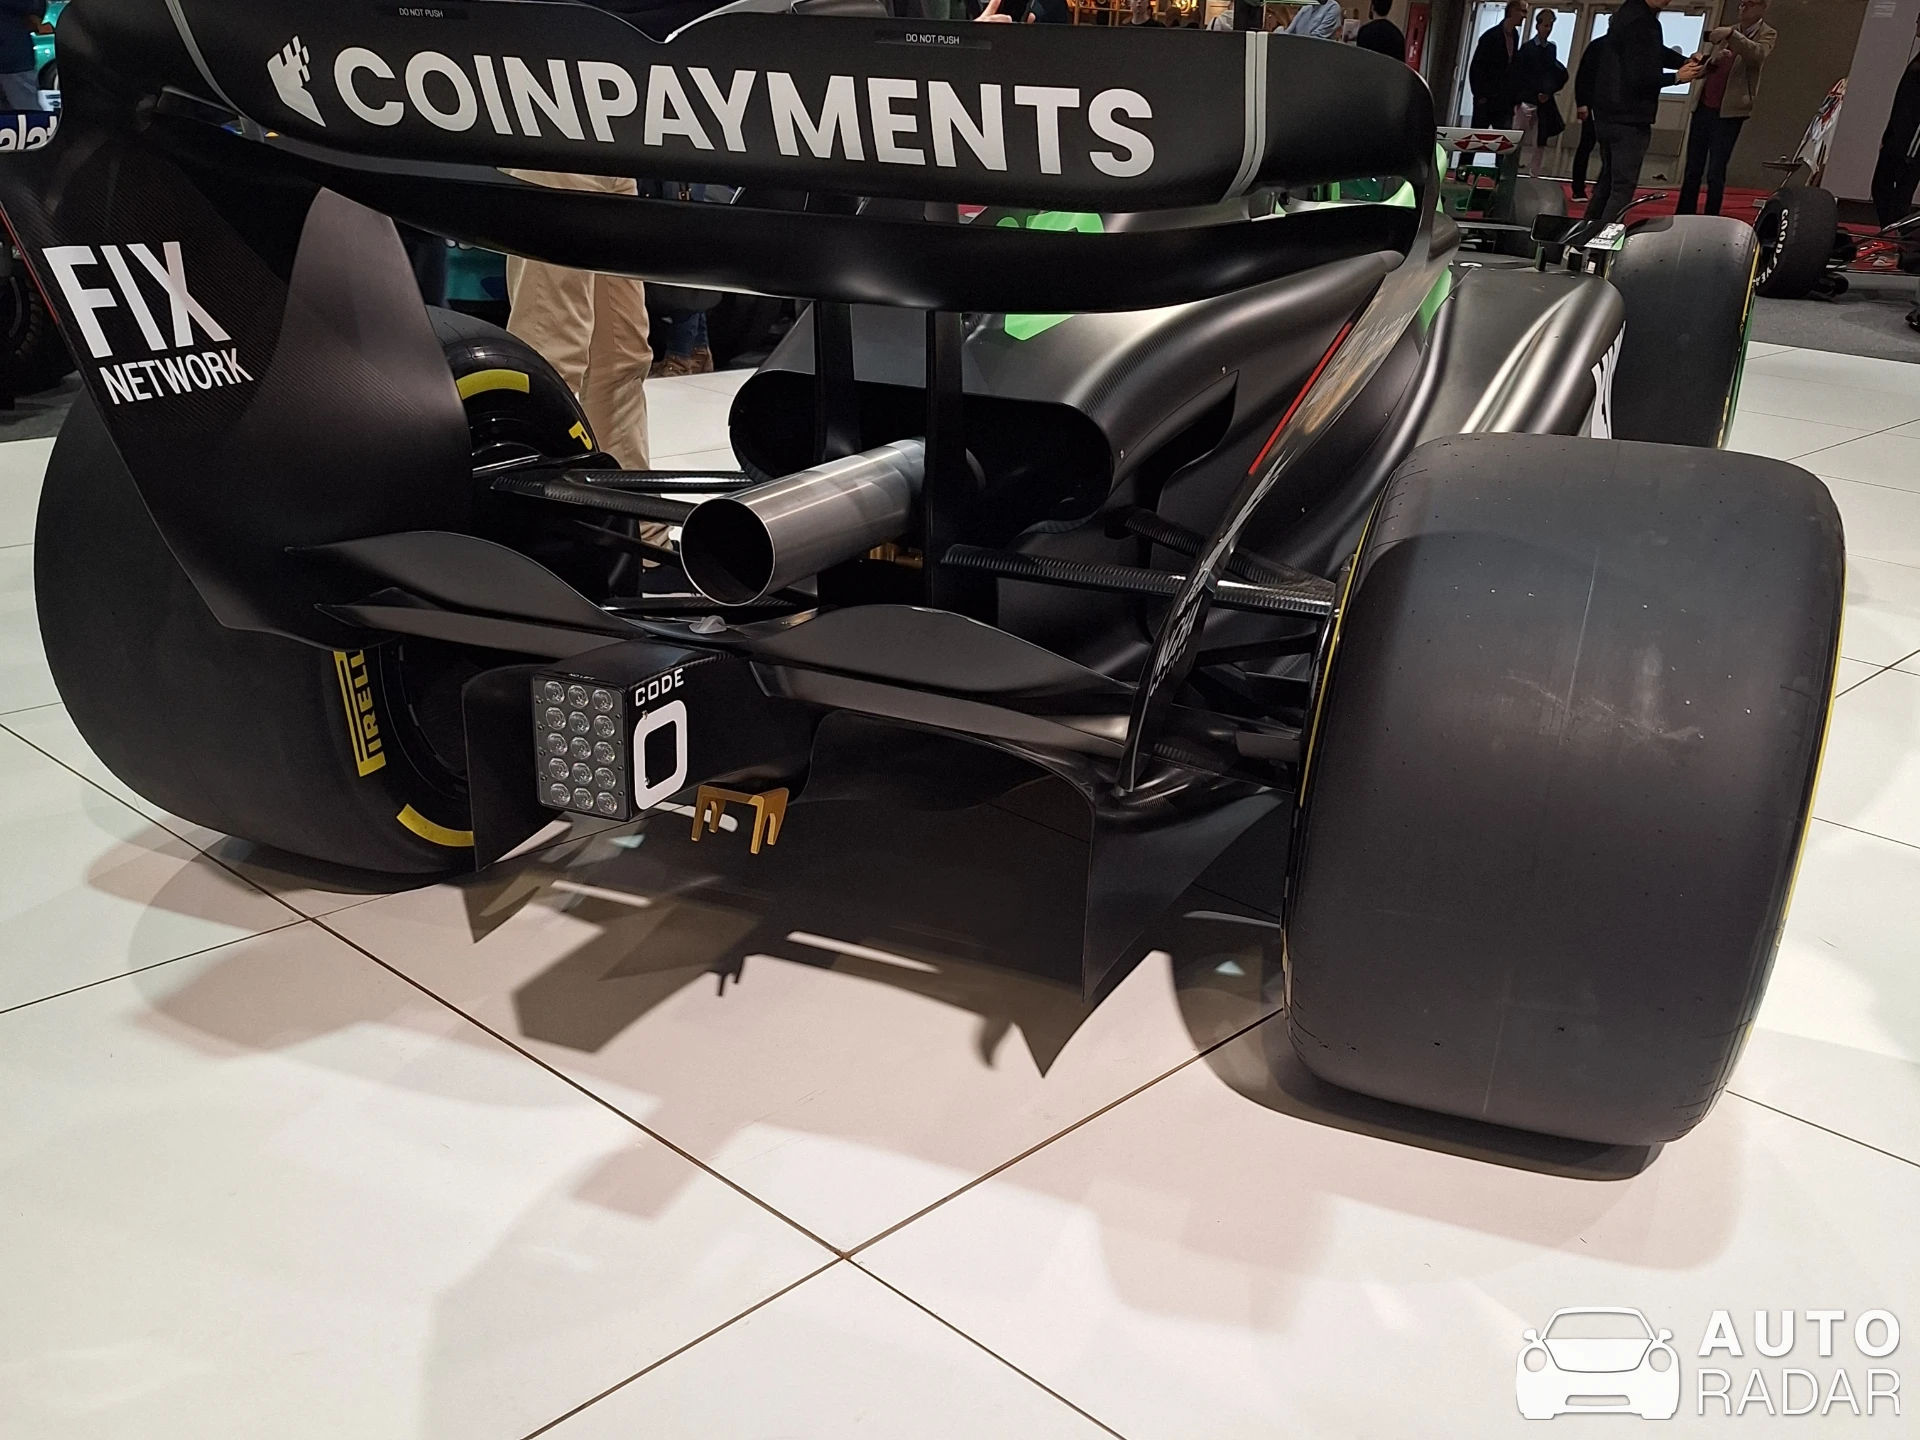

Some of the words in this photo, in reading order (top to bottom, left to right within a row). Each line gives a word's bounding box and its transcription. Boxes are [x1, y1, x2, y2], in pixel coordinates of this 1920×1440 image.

[398, 7, 410, 16] DO
[410, 8, 424, 17] NOT
[425, 9, 444, 18] PUSH
[905, 33, 918, 43] DO
[919, 34, 936, 44] NOT
[938, 35, 960, 45] PUSH
[334, 47, 1154, 178] COINPAYMENTS
[42, 241, 231, 358] FIX
[99, 348, 254, 405] NETWORK
[333, 649, 387, 777] PIRELL
[635, 668, 685, 707] CODE
